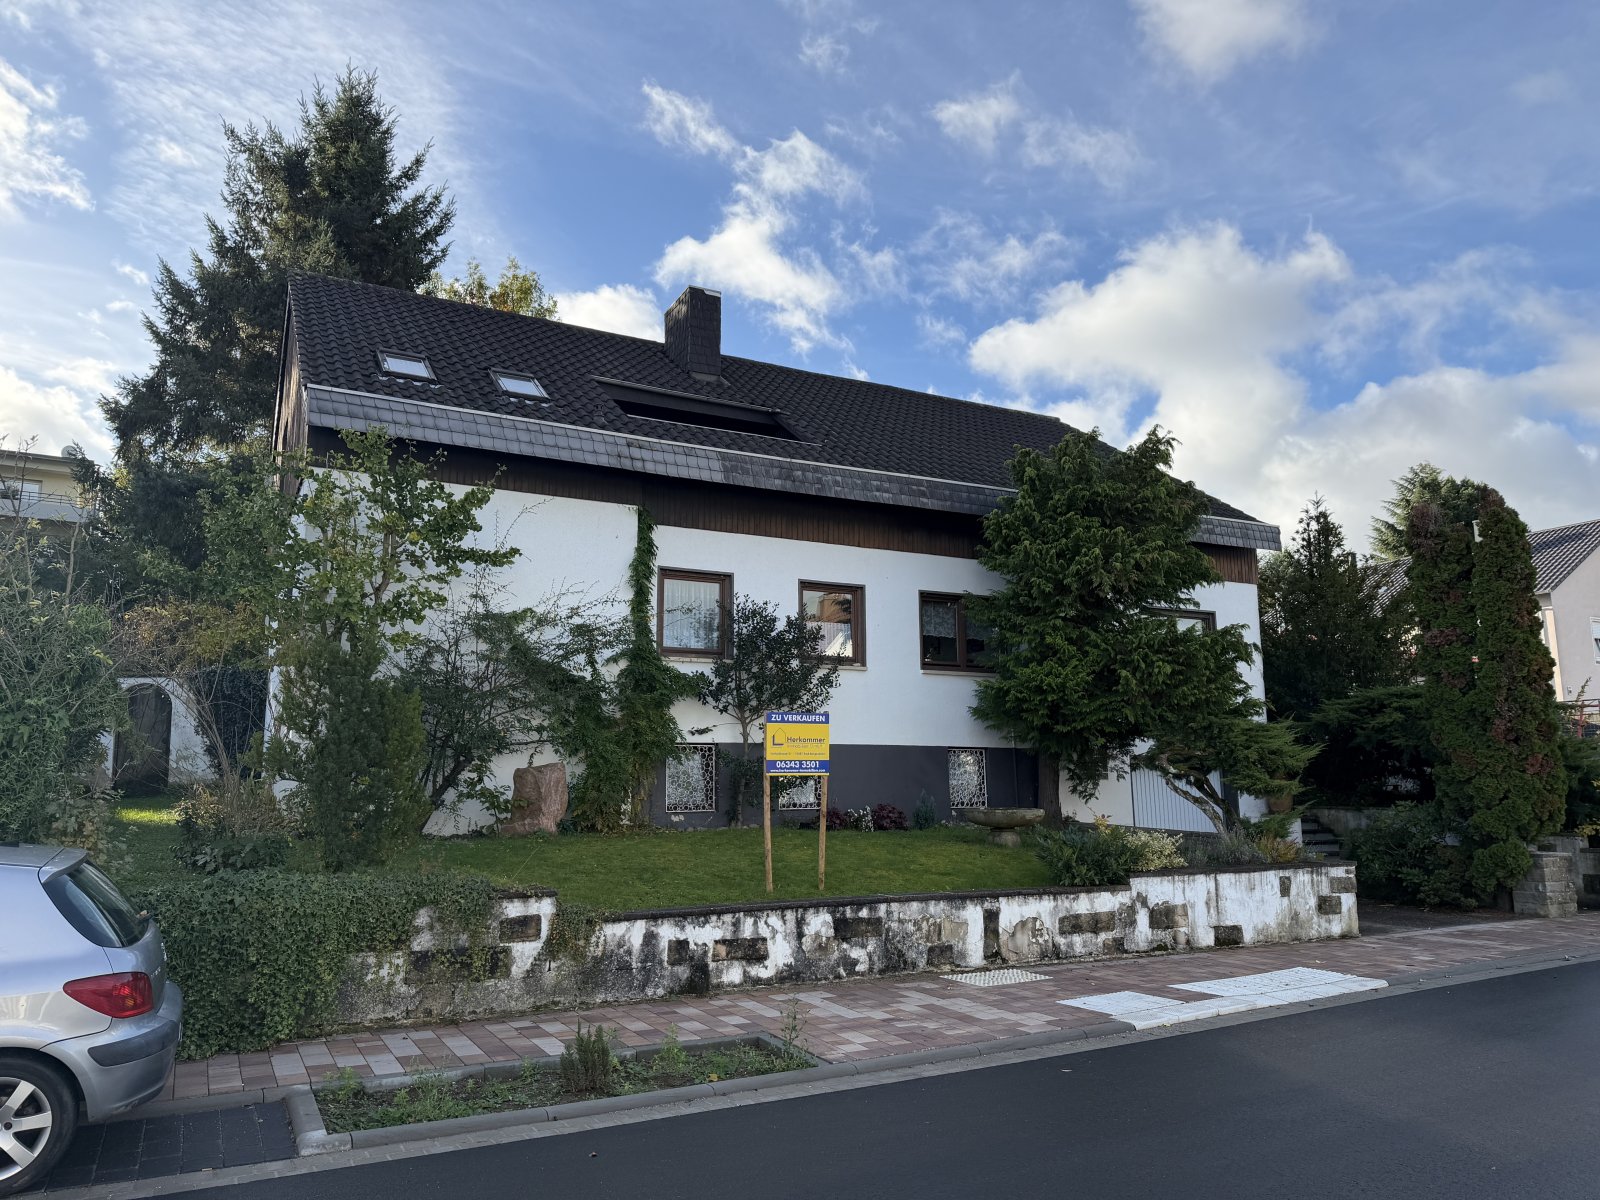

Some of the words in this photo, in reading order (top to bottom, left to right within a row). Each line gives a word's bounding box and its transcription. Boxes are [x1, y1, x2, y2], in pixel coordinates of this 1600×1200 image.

[783, 714, 826, 722] VERKAUFEN
[776, 760, 799, 768] 06343
[801, 760, 819, 768] 3501
